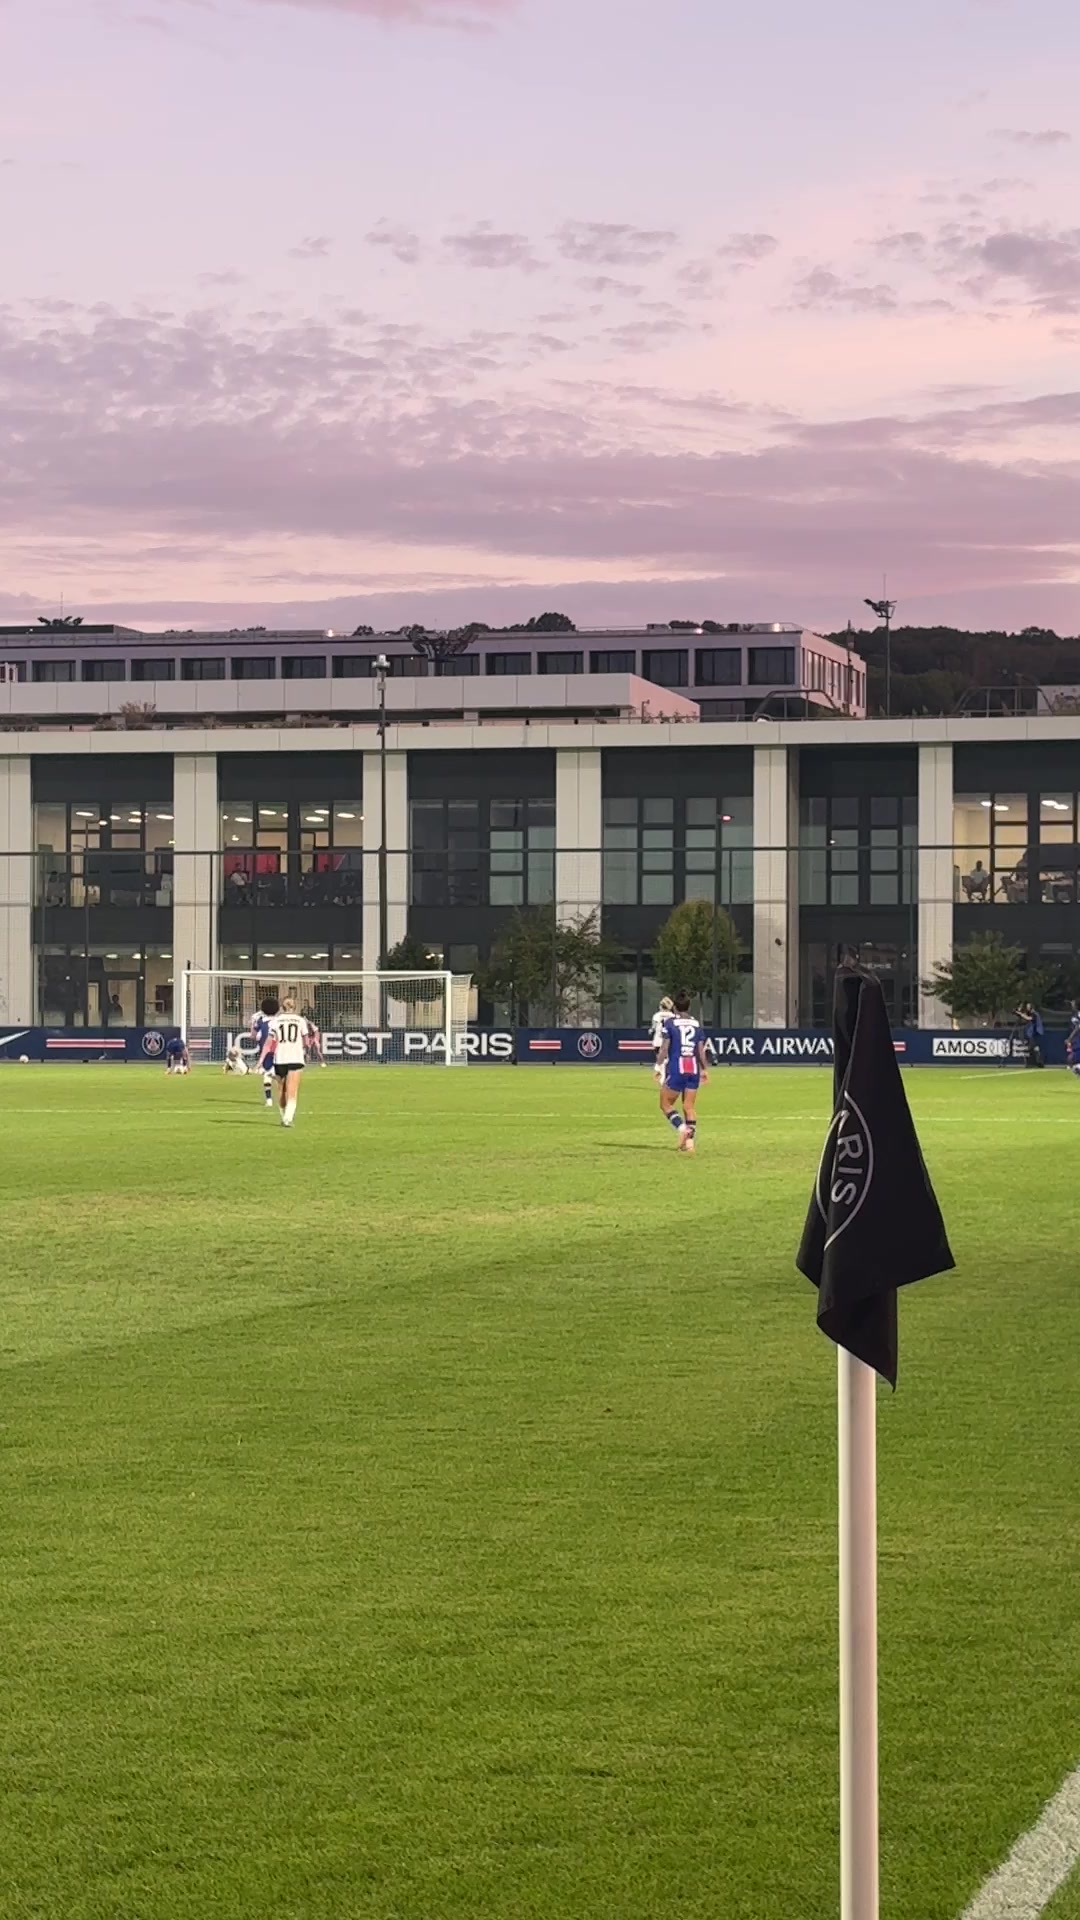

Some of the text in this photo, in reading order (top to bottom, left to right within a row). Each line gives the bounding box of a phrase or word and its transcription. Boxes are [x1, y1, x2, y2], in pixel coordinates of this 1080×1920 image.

[278, 1023, 298, 1043] 10
[679, 1025, 696, 1046] 12
[227, 1032, 261, 1055] IC
[404, 1032, 513, 1056] PARIS
[703, 1037, 755, 1055] ATAR
[760, 1037, 834, 1055] AIRWAY
[935, 1040, 987, 1054] AMOS
